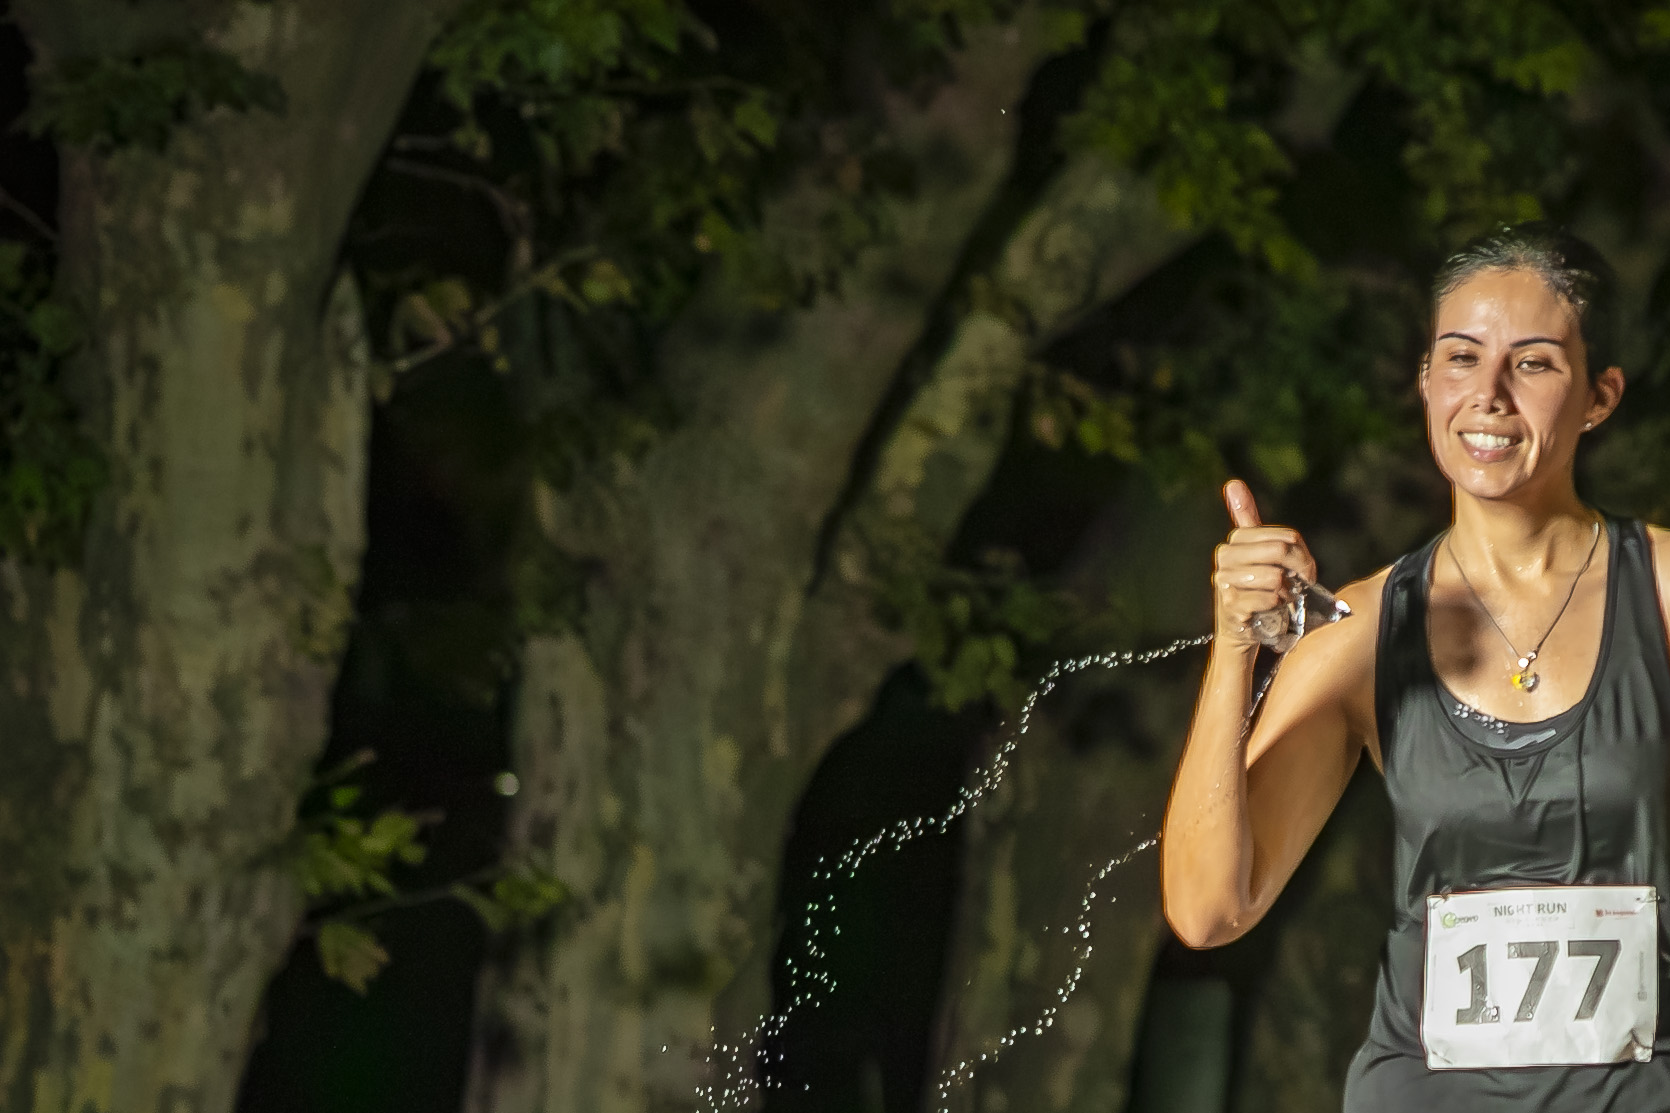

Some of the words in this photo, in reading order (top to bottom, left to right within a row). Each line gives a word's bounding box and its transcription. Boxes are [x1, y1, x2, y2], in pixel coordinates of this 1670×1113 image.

[1493, 902, 1535, 917] NIGHT
[1536, 902, 1568, 915] RUN
[1455, 938, 1622, 1026] 177
